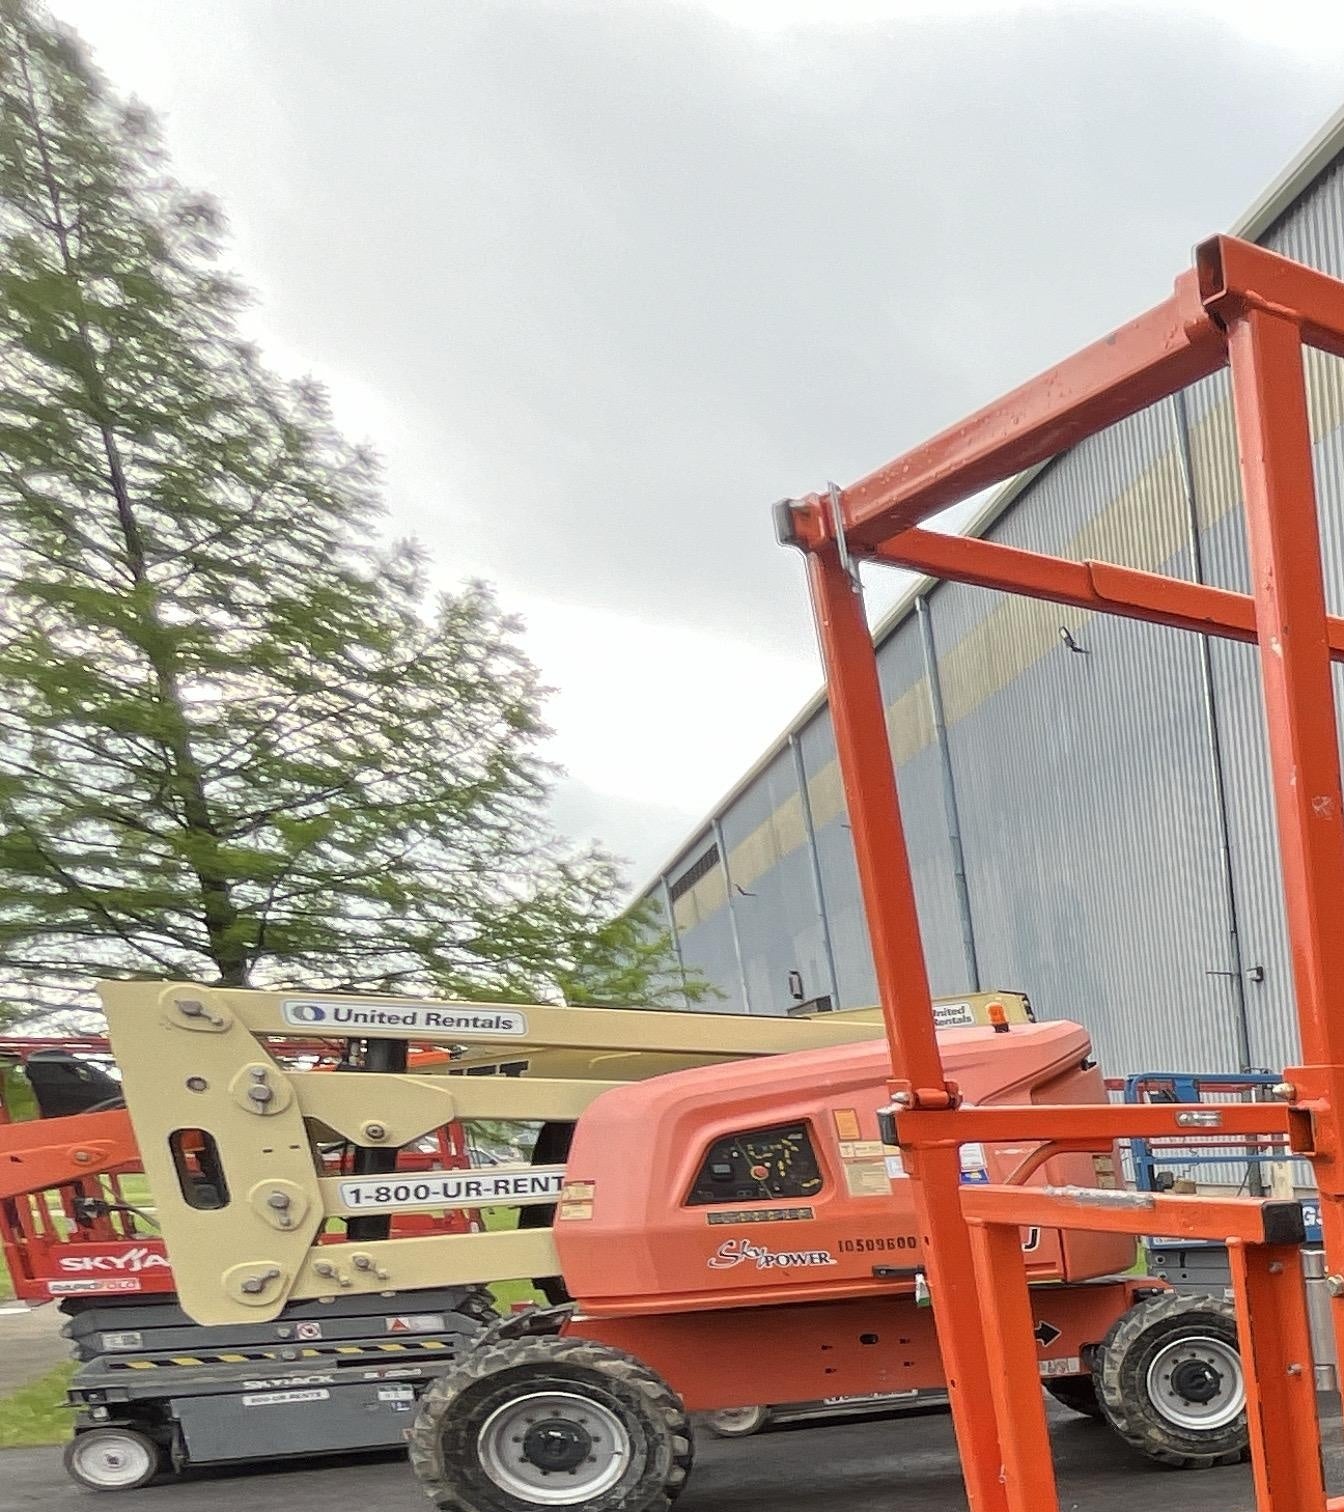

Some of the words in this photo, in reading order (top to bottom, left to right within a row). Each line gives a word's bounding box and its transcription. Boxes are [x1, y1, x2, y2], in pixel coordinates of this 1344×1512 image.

[333, 1006, 418, 1027] United
[425, 1010, 513, 1031] Rentals
[350, 1175, 566, 1205] 1-800-UR-RENT
[59, 1247, 172, 1272] SKYJA
